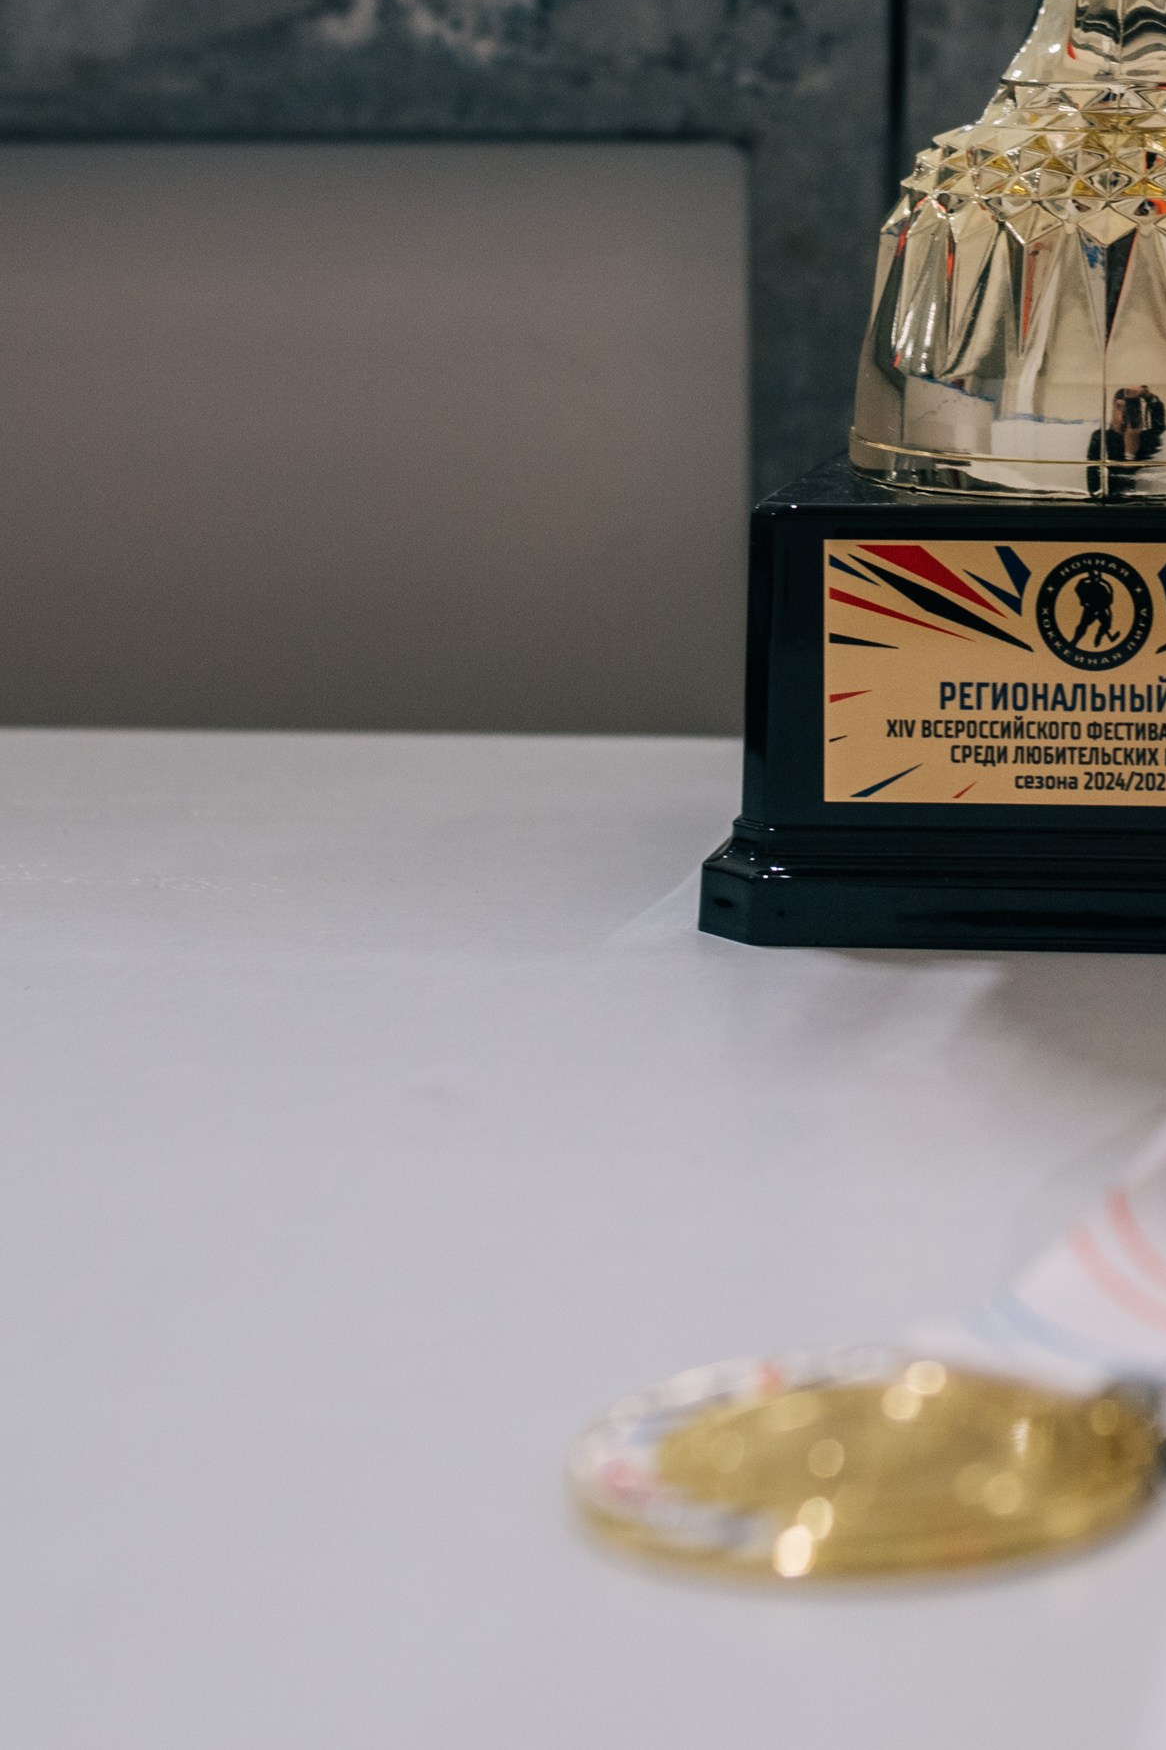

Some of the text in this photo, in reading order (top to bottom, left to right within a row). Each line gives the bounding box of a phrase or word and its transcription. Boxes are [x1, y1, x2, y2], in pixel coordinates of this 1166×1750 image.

[1060, 559, 1130, 577] НОЧНАЯ
[1042, 607, 1148, 665] ХОККЕЙНАЯ ЛИГА
[886, 719, 916, 738] XIV
[921, 715, 1081, 740] ВСЕРОССИЙСКОГО
[951, 745, 1008, 767] СРЕДИ
[1012, 746, 1159, 766] ЛЮБИТЕЛЬСКИХ
[1014, 775, 1079, 790] сезона
